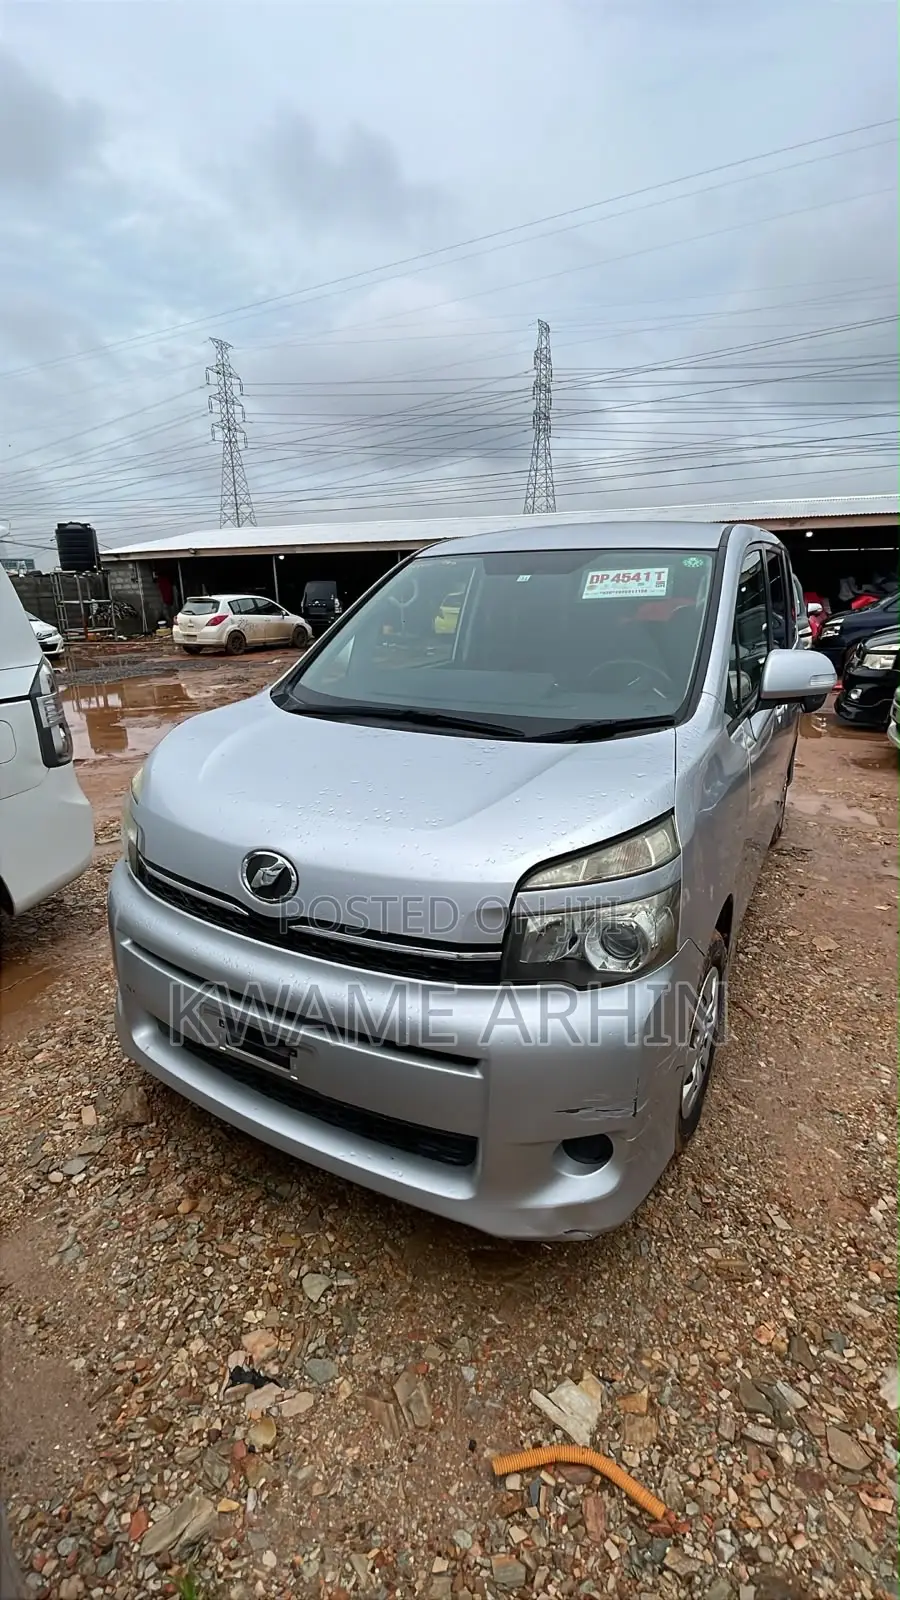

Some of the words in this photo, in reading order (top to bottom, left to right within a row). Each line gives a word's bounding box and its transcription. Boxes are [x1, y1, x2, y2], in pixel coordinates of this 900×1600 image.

[589, 574, 610, 585] DP
[610, 572, 651, 583] 4541
[655, 571, 665, 581] T
